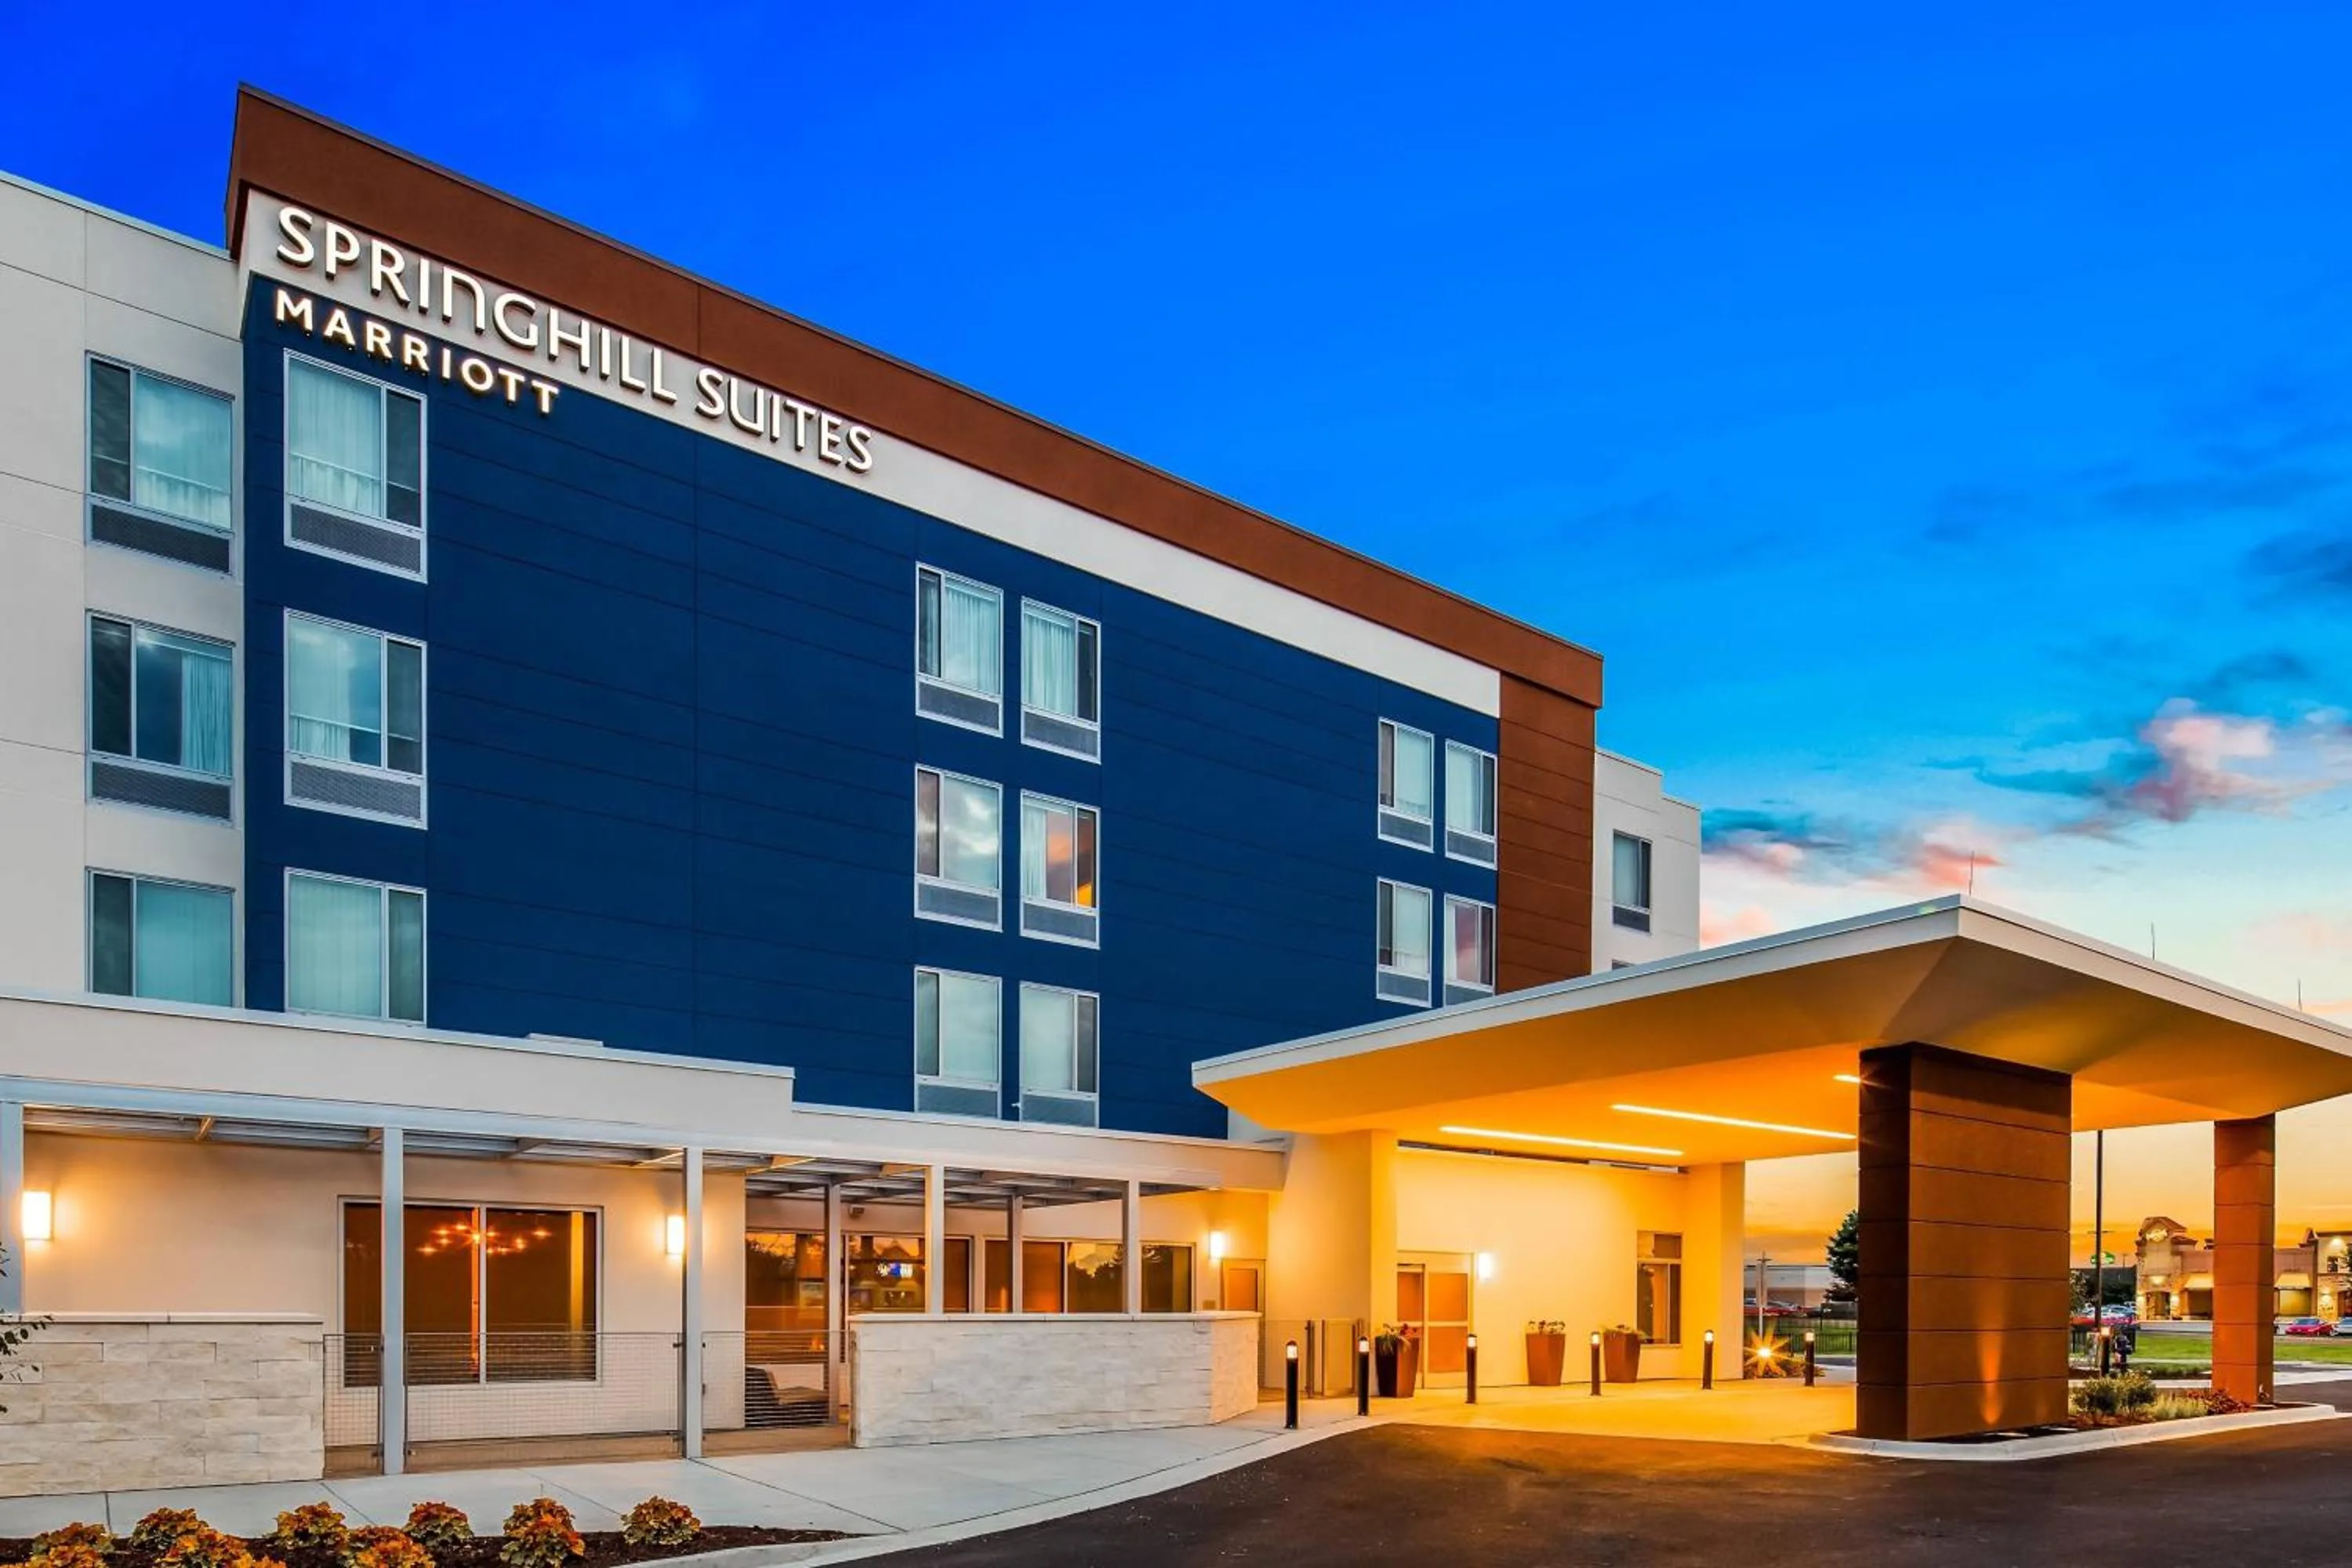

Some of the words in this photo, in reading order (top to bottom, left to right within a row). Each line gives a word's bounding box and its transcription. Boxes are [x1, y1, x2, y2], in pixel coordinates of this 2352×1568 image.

[275, 289, 561, 415] MARRIOTT
[276, 205, 678, 405] SPRINGHILL
[695, 368, 873, 474] SUITES
